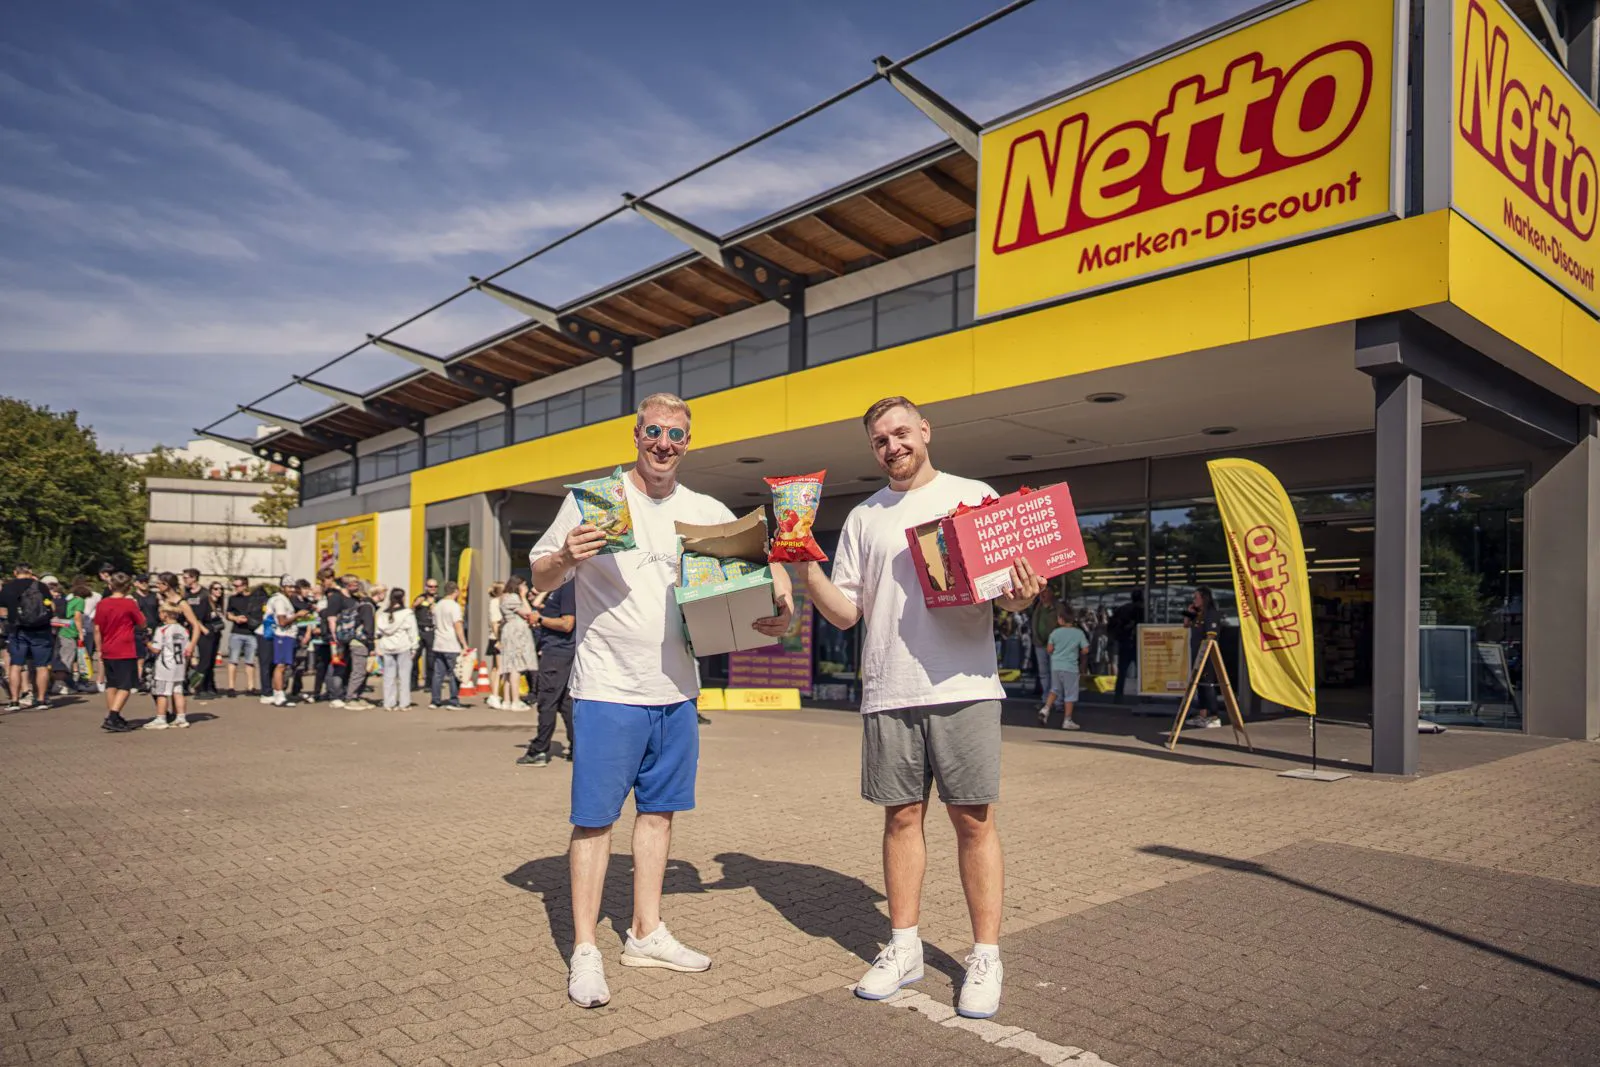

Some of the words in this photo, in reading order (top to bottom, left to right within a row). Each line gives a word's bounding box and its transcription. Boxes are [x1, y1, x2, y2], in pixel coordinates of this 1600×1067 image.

[1459, 0, 1599, 242] Netto
[992, 39, 1373, 255] Netto
[1077, 171, 1362, 275] Marken-Discount
[1503, 197, 1595, 292] Marken-Discount
[974, 507, 1014, 528] HAPPY
[1017, 495, 1052, 514] CHIPS
[977, 519, 1017, 540] HAPPY
[1020, 507, 1056, 526] CHIPS
[981, 531, 1020, 553] HAPPY
[1023, 519, 1059, 538] CHIPS
[984, 543, 1024, 565] HAPPY
[1026, 531, 1062, 550] CHIPS
[1046, 550, 1077, 566] PAPRIKA
